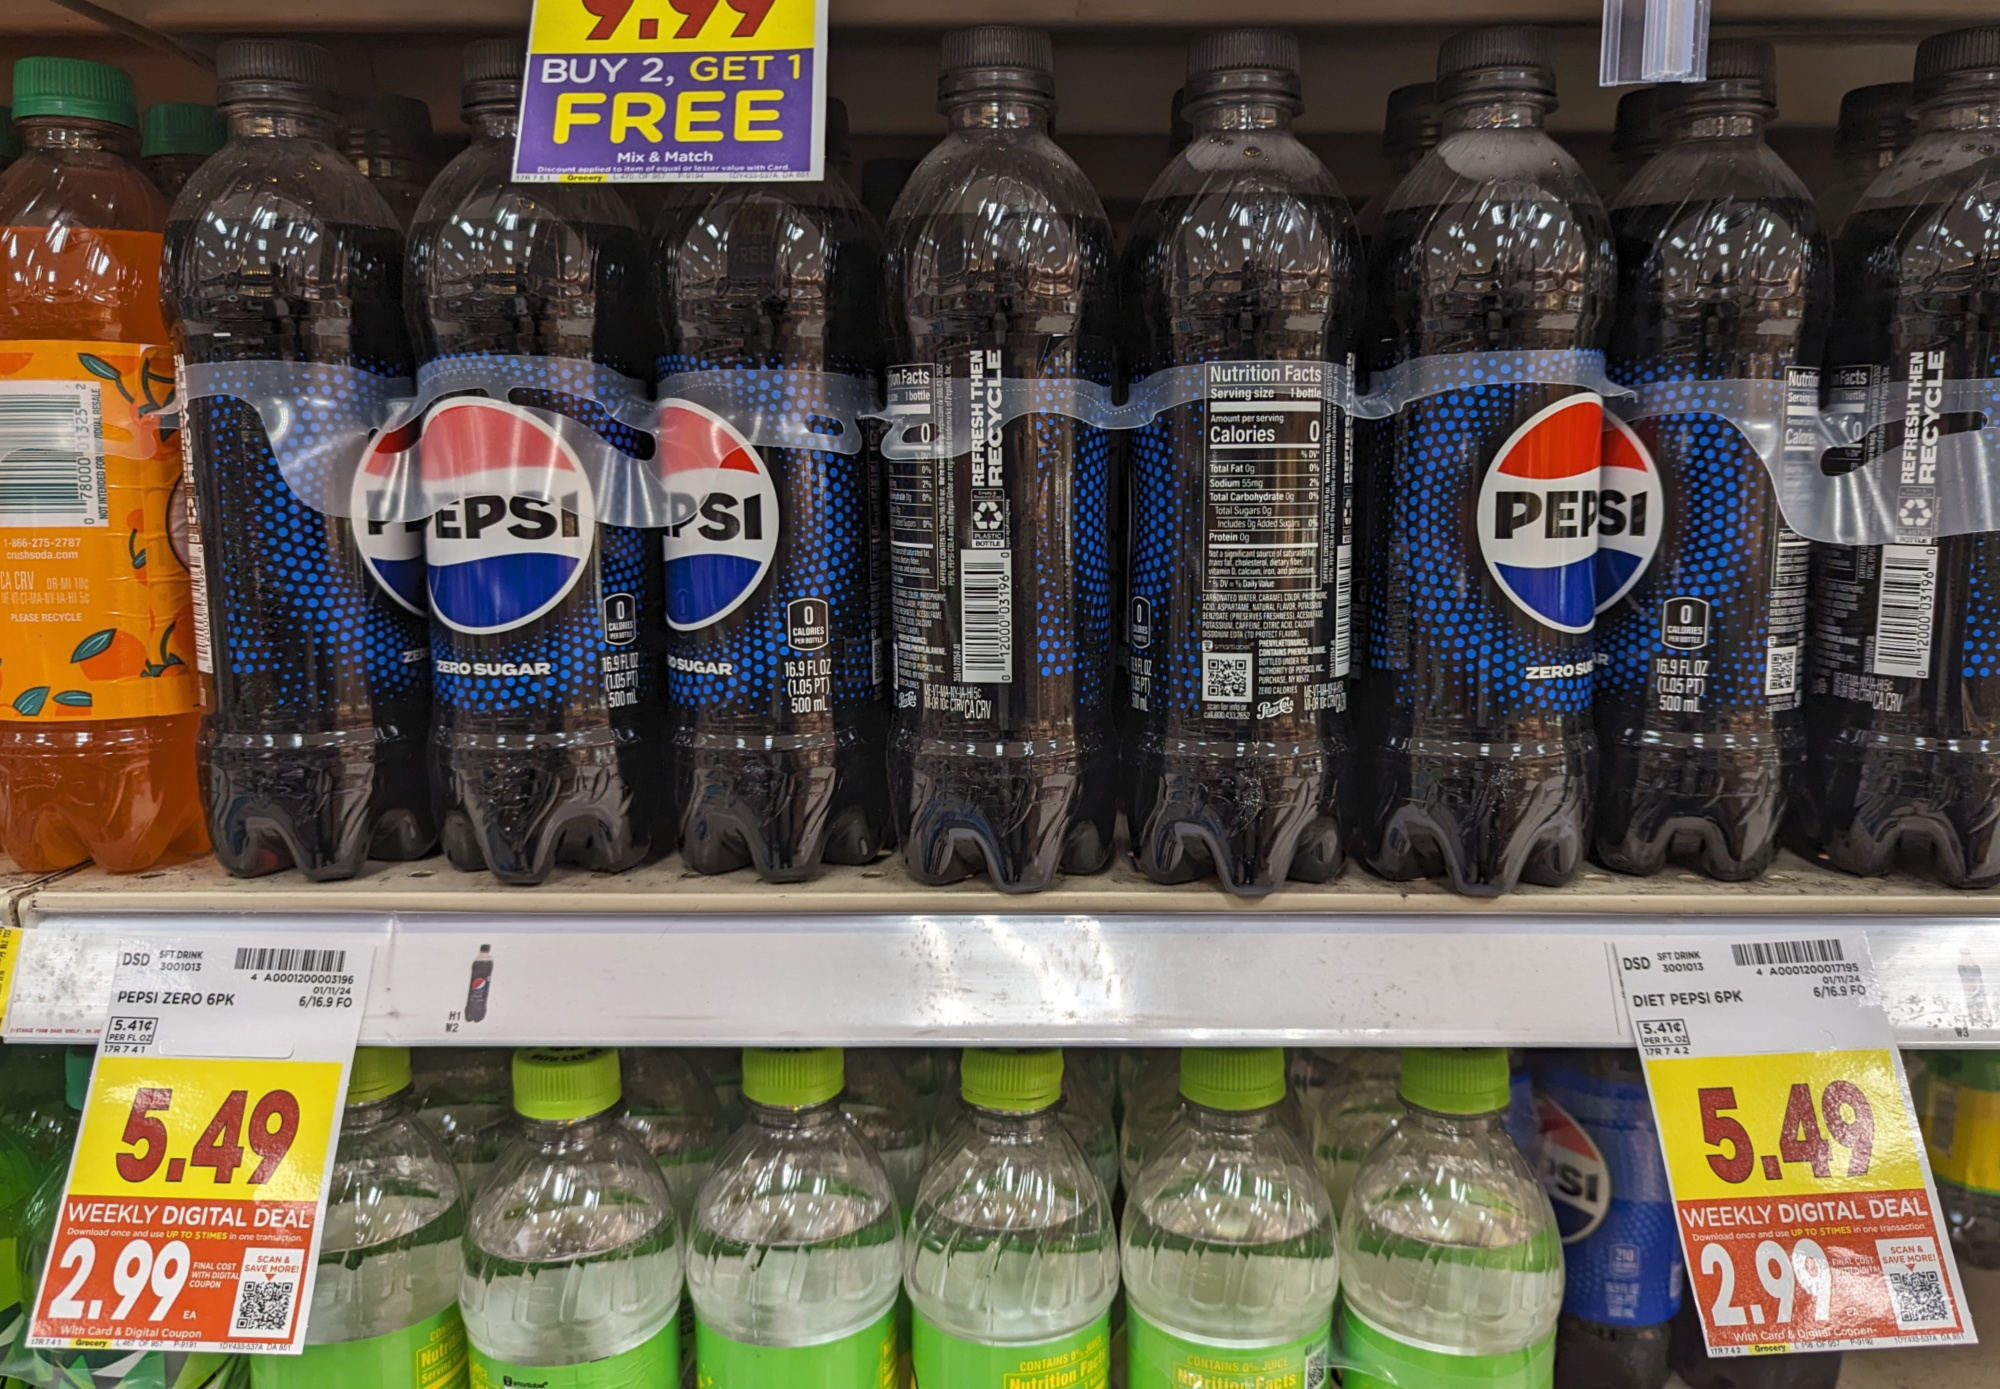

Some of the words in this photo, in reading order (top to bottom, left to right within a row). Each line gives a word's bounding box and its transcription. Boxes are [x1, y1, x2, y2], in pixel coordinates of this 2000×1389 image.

[541, 57, 628, 84] BUY
[640, 57, 675, 87] 2,
[690, 55, 774, 81] GET
[788, 54, 801, 80] 1
[553, 89, 785, 144] FREE
[617, 152, 645, 163] Mix
[649, 151, 660, 163] &
[665, 151, 714, 163] Match
[578, 166, 611, 174] applied
[656, 165, 680, 174] equal
[901, 369, 930, 385] Facts
[970, 350, 984, 400] THEN
[1210, 364, 1280, 383] Nutrition
[1284, 364, 1322, 382] Facts
[1907, 351, 1924, 400] THEN
[1210, 387, 1251, 401] Serving
[1254, 387, 1275, 399] size
[1290, 387, 1295, 399] 1
[1296, 387, 1322, 399] bottle
[986, 350, 1004, 487] RECYCLE
[1210, 414, 1240, 423] Amount
[1241, 415, 1255, 425] per
[1256, 414, 1285, 425] serving
[1918, 351, 1944, 485] RECYCLE
[1210, 425, 1276, 443] Calories
[1309, 420, 1320, 443] 0
[971, 404, 985, 487] REFRESH
[1901, 403, 1921, 484] REFRESH
[78, 457, 93, 500] 78000
[3, 537, 82, 548] 1-866-275-2787
[6, 550, 79, 560] crushsoda.com
[14, 570, 35, 590] CRV
[999, 574, 1010, 614] 03196
[10, 612, 40, 622] PLEASE
[41, 612, 83, 622] RECYCLE
[804, 606, 814, 625] 0
[792, 626, 824, 637] CALORIES
[999, 620, 1010, 658] 12000
[437, 661, 471, 675] ZERO
[473, 662, 552, 677] SUGAR
[676, 660, 733, 676] SUGAR
[784, 661, 805, 677] 16.9
[807, 660, 820, 676] FL
[821, 659, 832, 675] OZ
[1525, 664, 1573, 680] ZERO
[1656, 659, 1678, 676] 16.9
[1680, 660, 1694, 676] FL
[1695, 660, 1710, 677] OZ
[787, 678, 812, 697] (1.05
[814, 676, 830, 695] PT)
[791, 697, 811, 713] 500
[964, 699, 975, 719] CA
[976, 700, 992, 719] CRV
[122, 952, 151, 967] DSD
[159, 950, 176, 960] SFT
[177, 951, 204, 960] DRINK
[1623, 957, 1651, 970] DSD
[1657, 952, 1673, 961] SFT
[1674, 951, 1701, 960] DRINK
[160, 962, 202, 972] 3001013
[1662, 963, 1704, 973] 3001013
[1756, 968, 1763, 976] 4
[1769, 963, 1860, 976] A0001200017195
[251, 973, 258, 982] 4
[264, 973, 355, 985] A0001200003196
[1822, 975, 1861, 984] 01/11/24
[117, 991, 159, 1004] PEPSI
[162, 992, 203, 1005] ZERO
[206, 993, 236, 1006] 6PK
[313, 986, 352, 996] 01/11/24
[1632, 994, 1665, 1007] DIET
[1671, 992, 1711, 1006] PEPSI
[1714, 990, 1743, 1004] 6PK
[1813, 985, 1848, 999] 6/16.9
[1850, 985, 1866, 996] FO
[299, 997, 334, 1009] 6/16.9
[336, 997, 353, 1008] FO
[448, 1011, 461, 1021] H1
[113, 1020, 153, 1032] 5.41¢
[446, 1023, 459, 1033] W2
[1643, 1022, 1682, 1035] 5.41¢
[109, 1034, 126, 1042] PER
[127, 1034, 137, 1042] FL
[139, 1034, 152, 1043] OZ
[116, 1087, 300, 1185] 5.49
[1697, 1080, 1875, 1184] 5.49
[68, 1203, 160, 1225] WEEKLY
[162, 1206, 248, 1227] DIGITAL
[253, 1208, 311, 1229] DEAL
[1682, 1204, 1773, 1228] WEEKLY
[1777, 1201, 1865, 1225] DIGITAL
[1868, 1197, 1928, 1219] DEAL
[67, 1227, 109, 1237] Download
[132, 1229, 149, 1238] and
[166, 1230, 179, 1239] UP
[181, 1231, 194, 1239] TO
[256, 1233, 304, 1242] transaction.
[1692, 1231, 1734, 1242] Download
[1736, 1231, 1756, 1240] once
[1757, 1230, 1773, 1239] and
[1774, 1230, 1790, 1238] use
[1790, 1228, 1803, 1237] UP
[1804, 1227, 1817, 1236] TO
[1853, 1224, 1862, 1233] in
[1863, 1224, 1878, 1233] one
[1879, 1222, 1926, 1232] transaction.
[1890, 1246, 1915, 1254] SCAN
[193, 1262, 214, 1270] FINAL
[216, 1263, 237, 1271] COST
[257, 1255, 283, 1263] SCAN
[1882, 1255, 1906, 1264] SAVE
[1906, 1254, 1936, 1264] MORE!
[191, 1271, 211, 1279] WITH
[212, 1271, 240, 1280] DIGITAL
[244, 1264, 268, 1272] SAVE
[270, 1265, 299, 1273] MORE!
[48, 1237, 191, 1321] 2.99
[189, 1280, 221, 1288] COUPON
[1700, 1238, 1833, 1328] 2.99
[183, 1310, 197, 1319] EA
[60, 1326, 85, 1335] With
[87, 1326, 112, 1336] Card
[114, 1327, 122, 1336] &
[125, 1327, 160, 1338] Digital
[161, 1328, 202, 1339] Coupon
[1020, 1353, 1068, 1372] CONTAINS
[1262, 1357, 1289, 1371] JUICE
[1009, 1369, 1077, 1389] Nutrition
